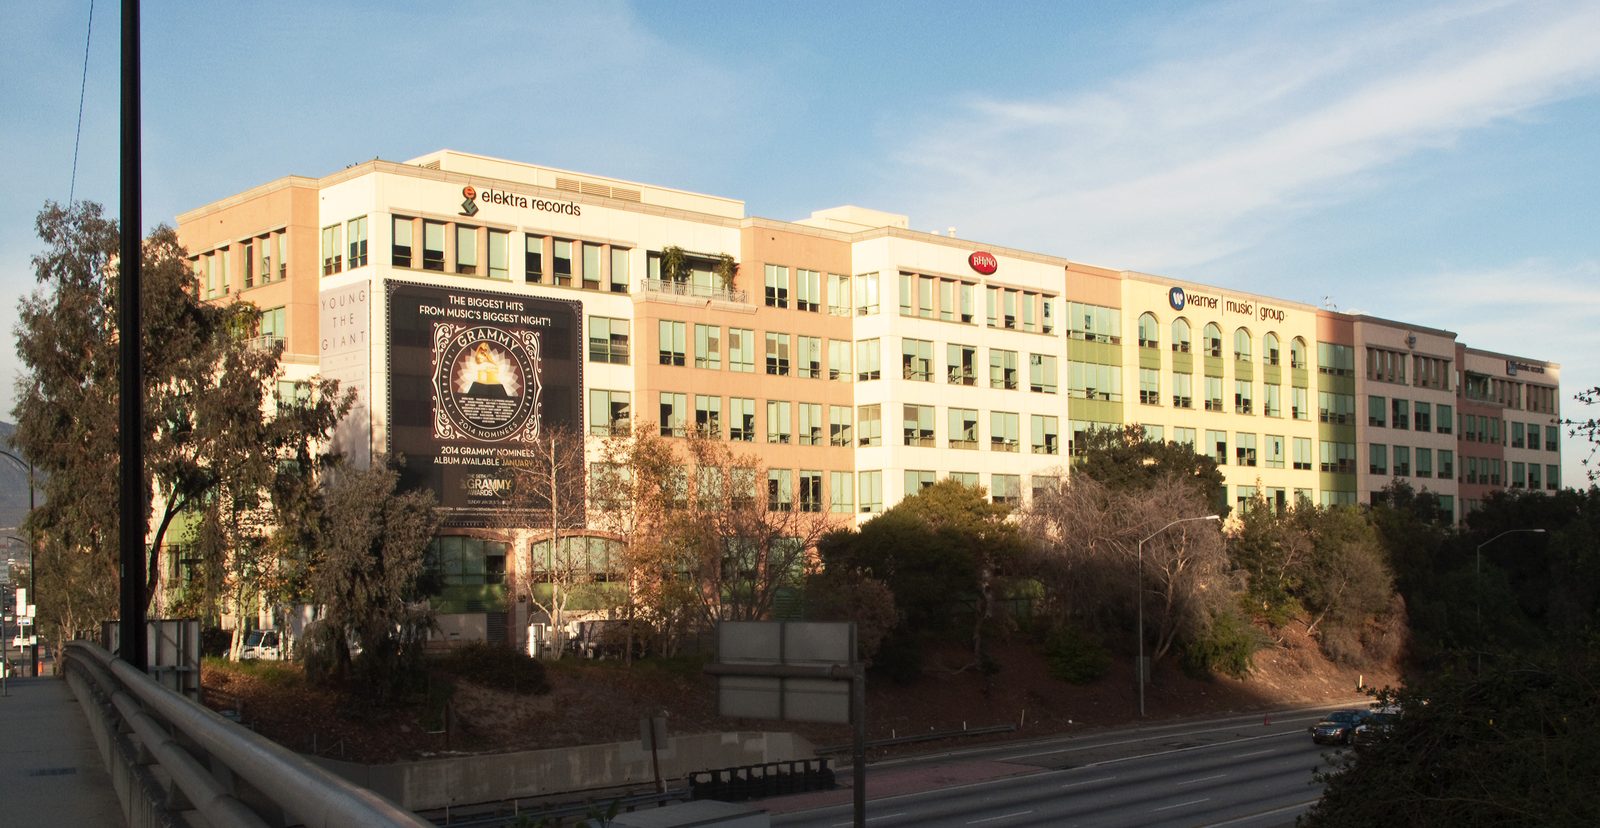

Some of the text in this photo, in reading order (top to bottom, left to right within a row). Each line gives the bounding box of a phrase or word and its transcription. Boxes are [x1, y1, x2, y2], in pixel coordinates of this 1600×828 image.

[481, 189, 581, 217] elektra records
[973, 256, 997, 268] RHINO
[321, 290, 365, 311] YOUNG
[448, 295, 524, 312] THE BIGGEST HITS
[1186, 293, 1285, 324] warner music group
[332, 312, 354, 329] THE
[419, 305, 445, 317] FROM
[446, 308, 481, 320] MUSIC'S
[482, 311, 519, 324] BIGGEST
[321, 330, 365, 351] GIANT
[457, 328, 519, 351] GRAMMY
[458, 419, 518, 438] 2014 NOMINEES
[441, 446, 459, 455] 2014
[496, 448, 535, 458] NOMINEES
[433, 456, 460, 465] ALBUM
[461, 457, 500, 467] AVAILABLE
[501, 459, 533, 468] JANUARY
